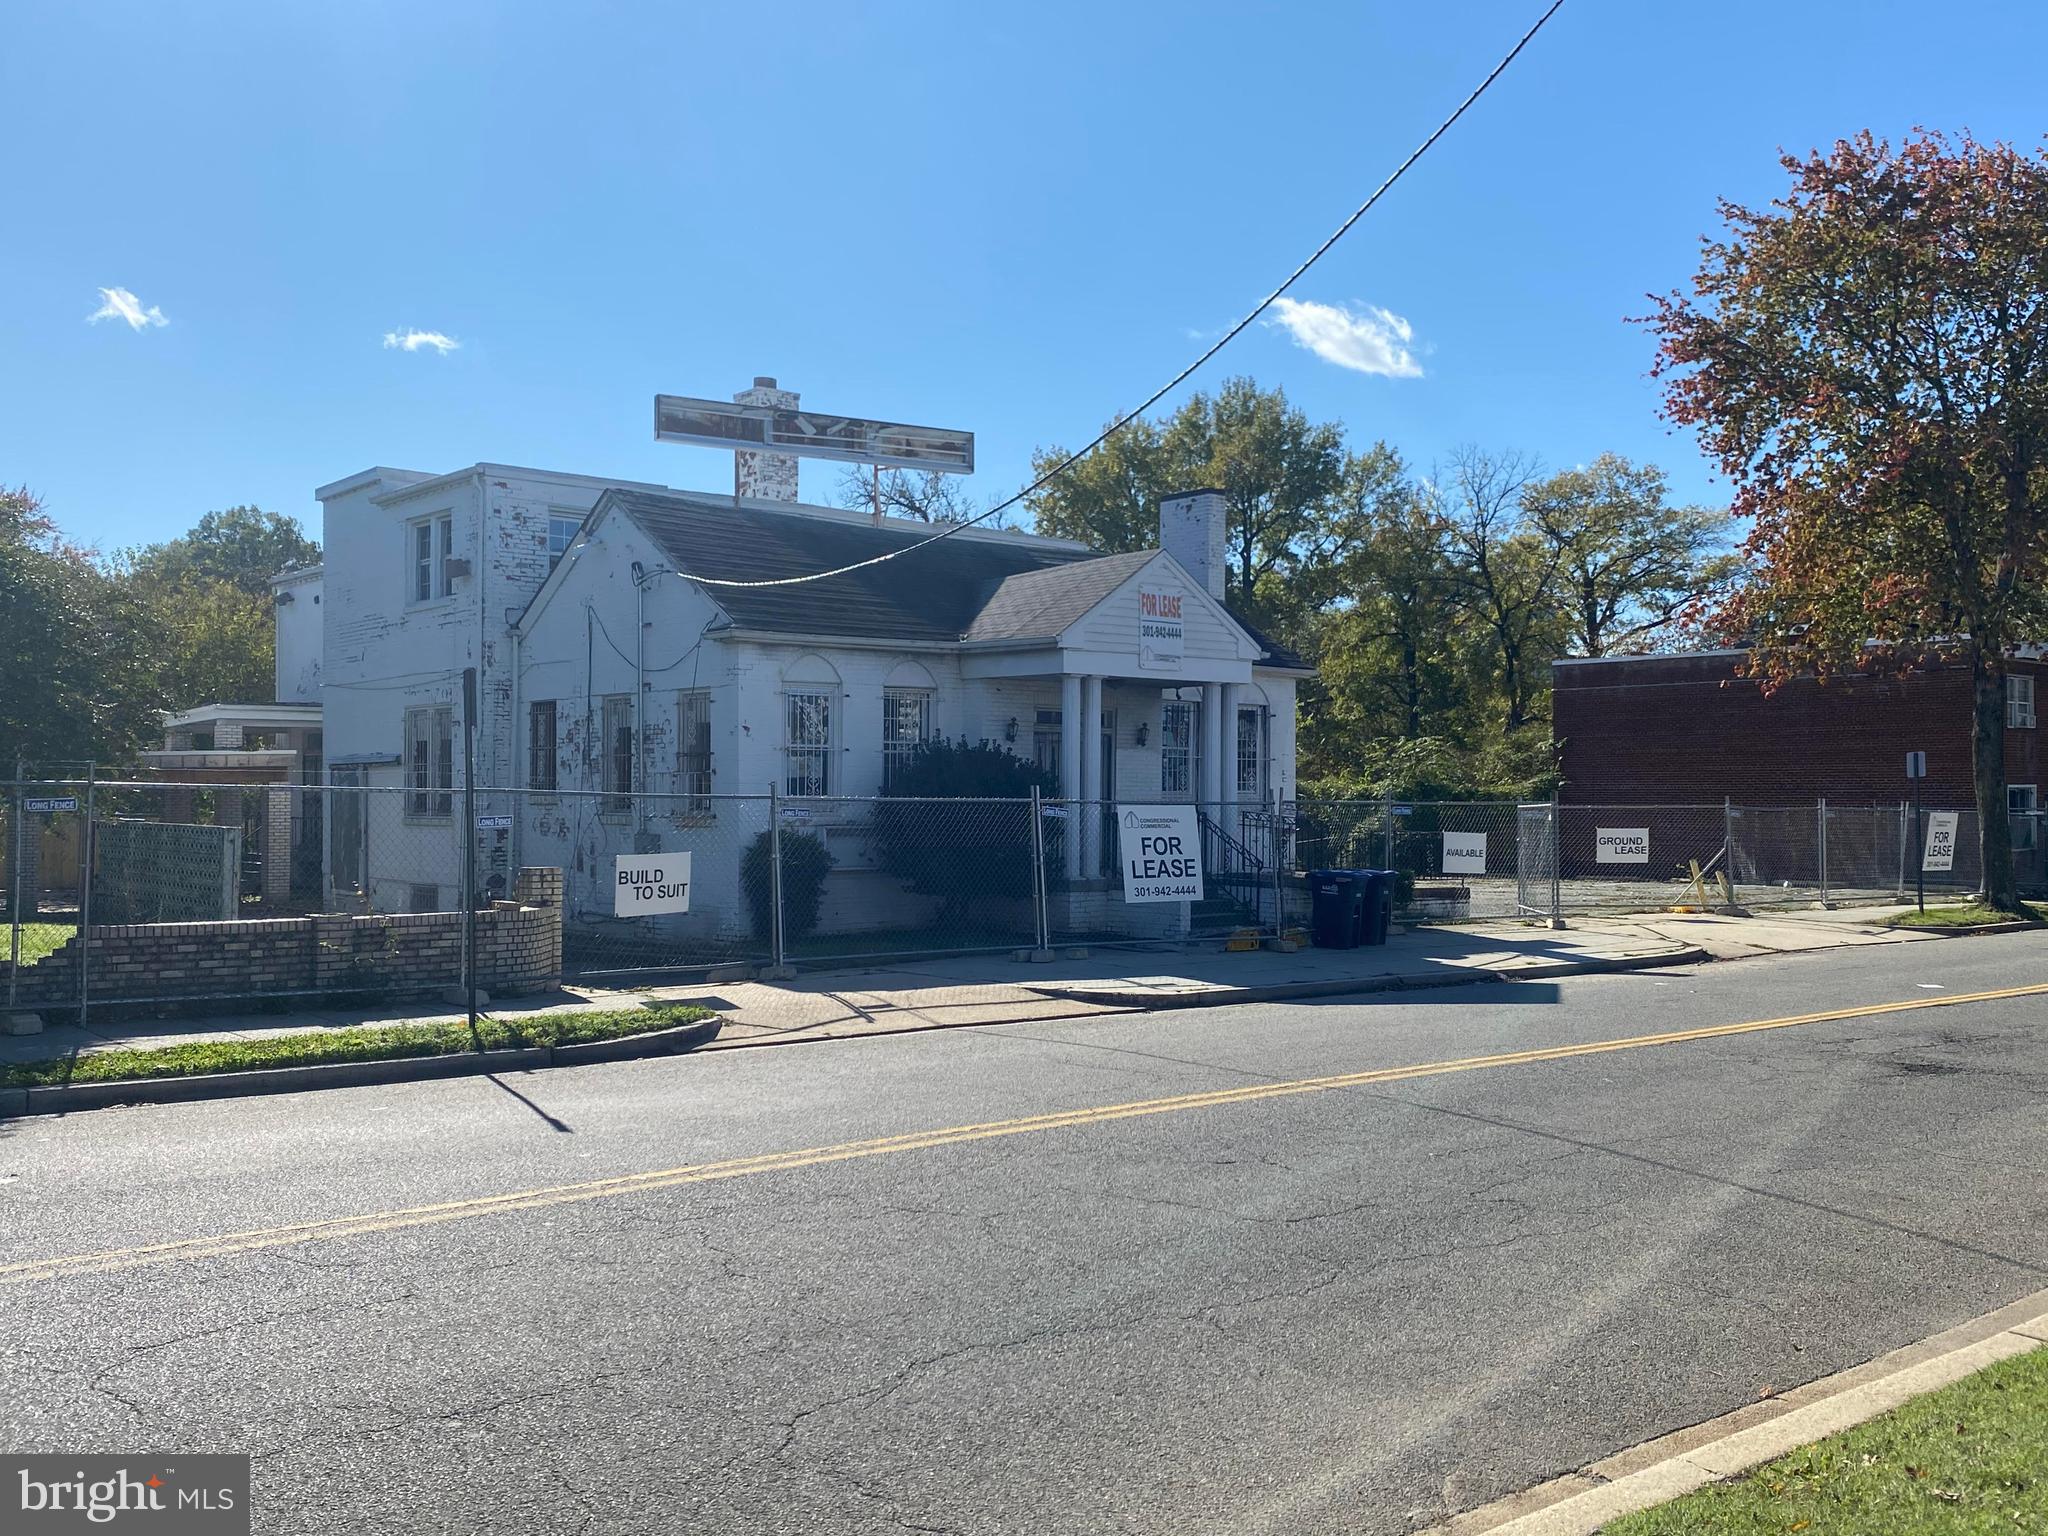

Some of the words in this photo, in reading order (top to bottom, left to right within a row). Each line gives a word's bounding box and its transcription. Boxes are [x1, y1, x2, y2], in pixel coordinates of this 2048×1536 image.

[1141, 593, 1157, 616] FOR
[1159, 595, 1182, 618] LEASE
[1142, 625, 1182, 639] 301-942-4444
[27, 801, 48, 809] LONG
[50, 800, 75, 809] FENCE
[478, 818, 495, 826] LONG
[1599, 836, 1643, 846] GROUND
[1934, 831, 1950, 843] FOR
[1141, 836, 1183, 856] FOR
[1614, 845, 1647, 855] LEASE
[1928, 845, 1952, 857] LEASE
[1446, 848, 1484, 858] AVAILABLE
[1131, 858, 1197, 879] LEASE
[618, 869, 664, 885] BUILD
[633, 885, 654, 901] TO
[657, 882, 688, 899] SUIT
[1134, 885, 1197, 897] 301-942-4444
